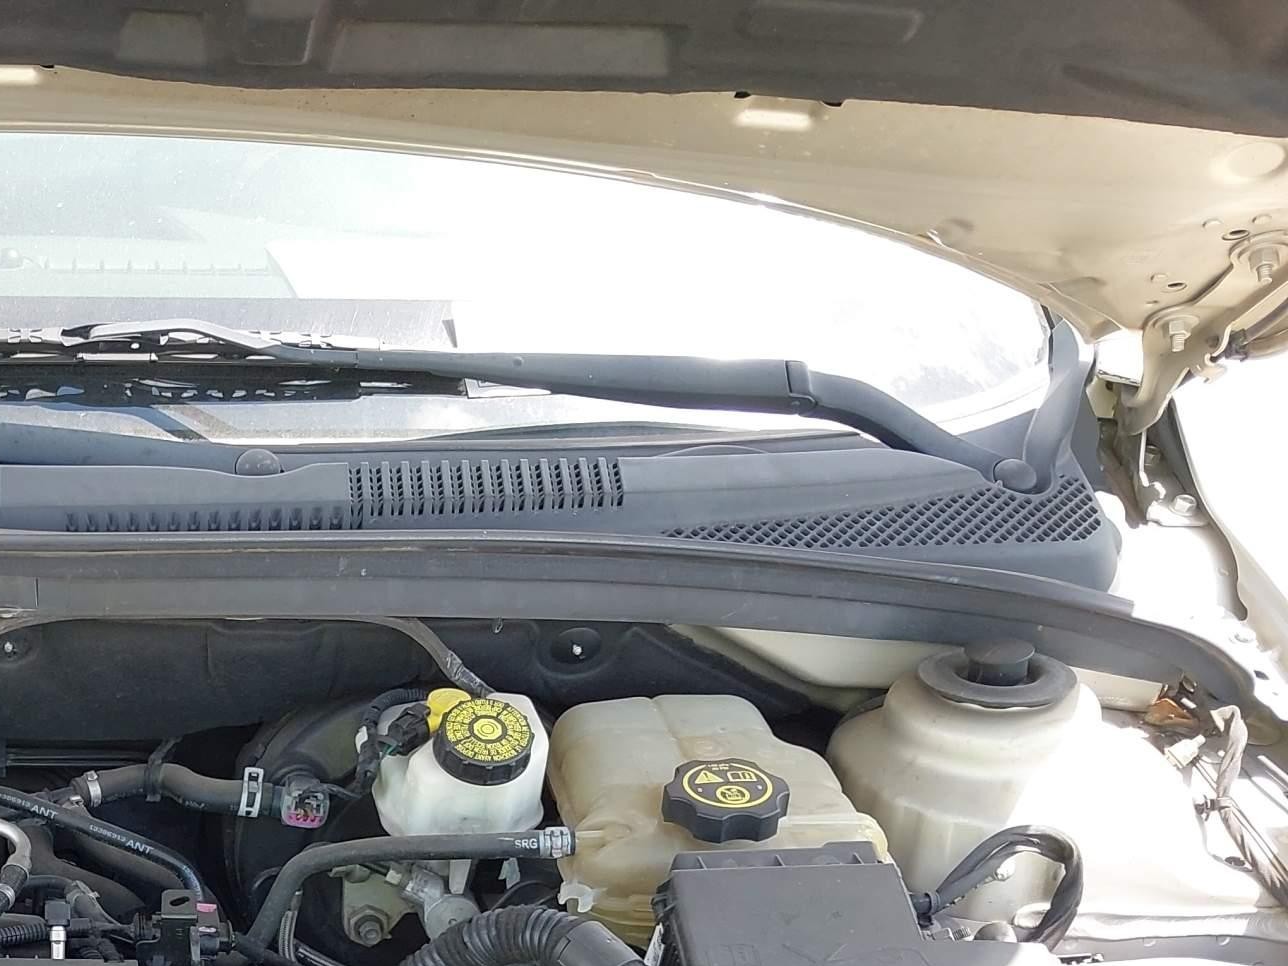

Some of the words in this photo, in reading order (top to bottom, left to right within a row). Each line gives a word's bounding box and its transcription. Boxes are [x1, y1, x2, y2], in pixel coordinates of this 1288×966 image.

[31, 805, 59, 820] ANT
[126, 840, 154, 854] ANT
[514, 838, 538, 848] SRG
